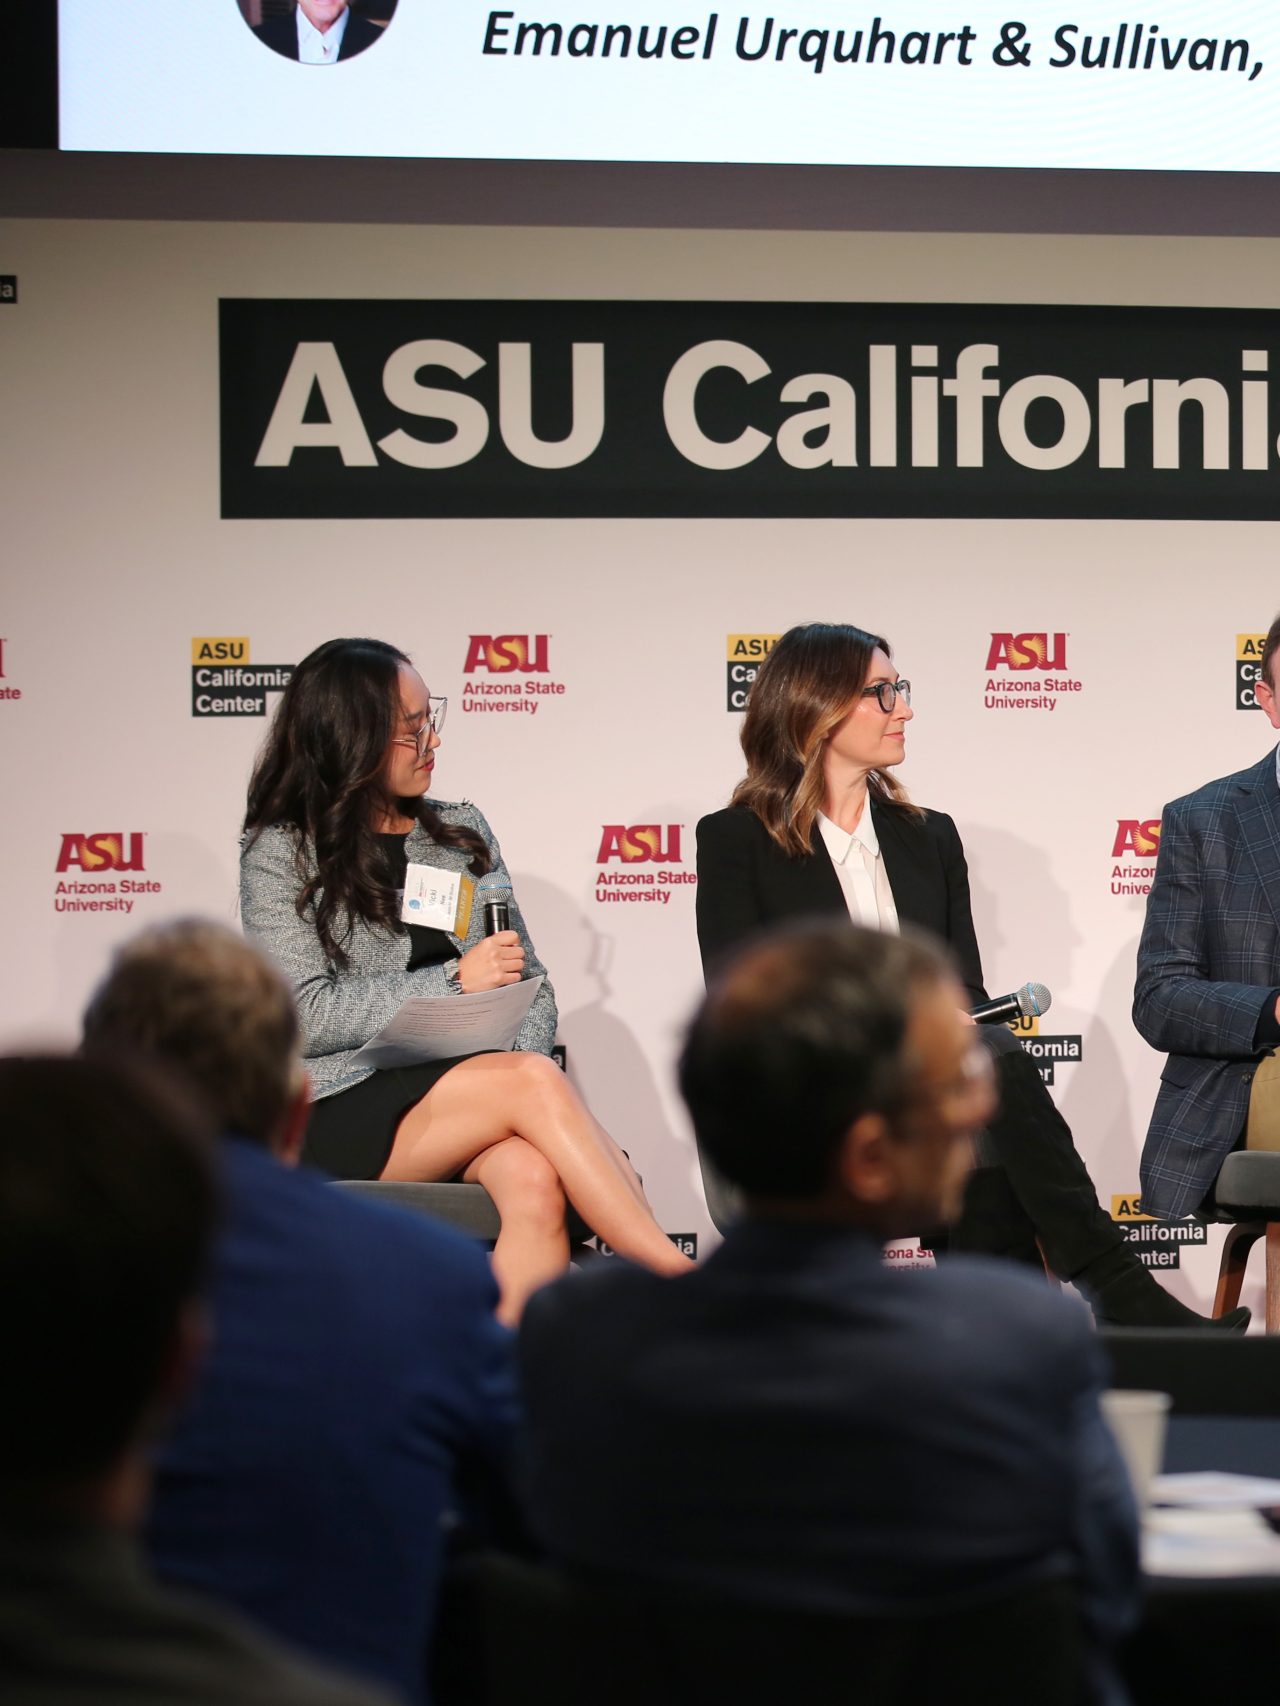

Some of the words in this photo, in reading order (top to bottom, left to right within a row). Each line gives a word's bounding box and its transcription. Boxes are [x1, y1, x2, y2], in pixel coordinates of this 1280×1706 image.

[483, 12, 718, 59] Emanuel
[736, 17, 976, 73] Urquhart
[993, 22, 1031, 66] &
[1050, 24, 1263, 80] Sullivan,
[255, 340, 605, 472] ASU
[199, 643, 244, 660] ASU
[463, 635, 550, 673] ASU
[985, 633, 1068, 671] ASU
[1243, 639, 1267, 655] AS
[196, 669, 291, 687] California
[985, 679, 1041, 692] Arizona
[1044, 679, 1082, 692] State
[463, 682, 521, 695] Arizona
[525, 681, 566, 695] State
[196, 695, 263, 713] Center
[463, 699, 539, 715] University
[985, 696, 1057, 711] University
[597, 825, 682, 863] ASU
[1112, 820, 1162, 857] AS
[56, 833, 145, 872] ASU
[597, 872, 654, 885] Arizona
[658, 871, 697, 884] State
[56, 881, 116, 894] Arizona
[120, 880, 161, 893] State
[1111, 882, 1151, 895] Unive
[596, 889, 671, 904] University
[55, 898, 134, 914] University
[1008, 1015, 1033, 1030] SU
[1118, 1199, 1141, 1216] AS
[1135, 1251, 1176, 1265] nter
